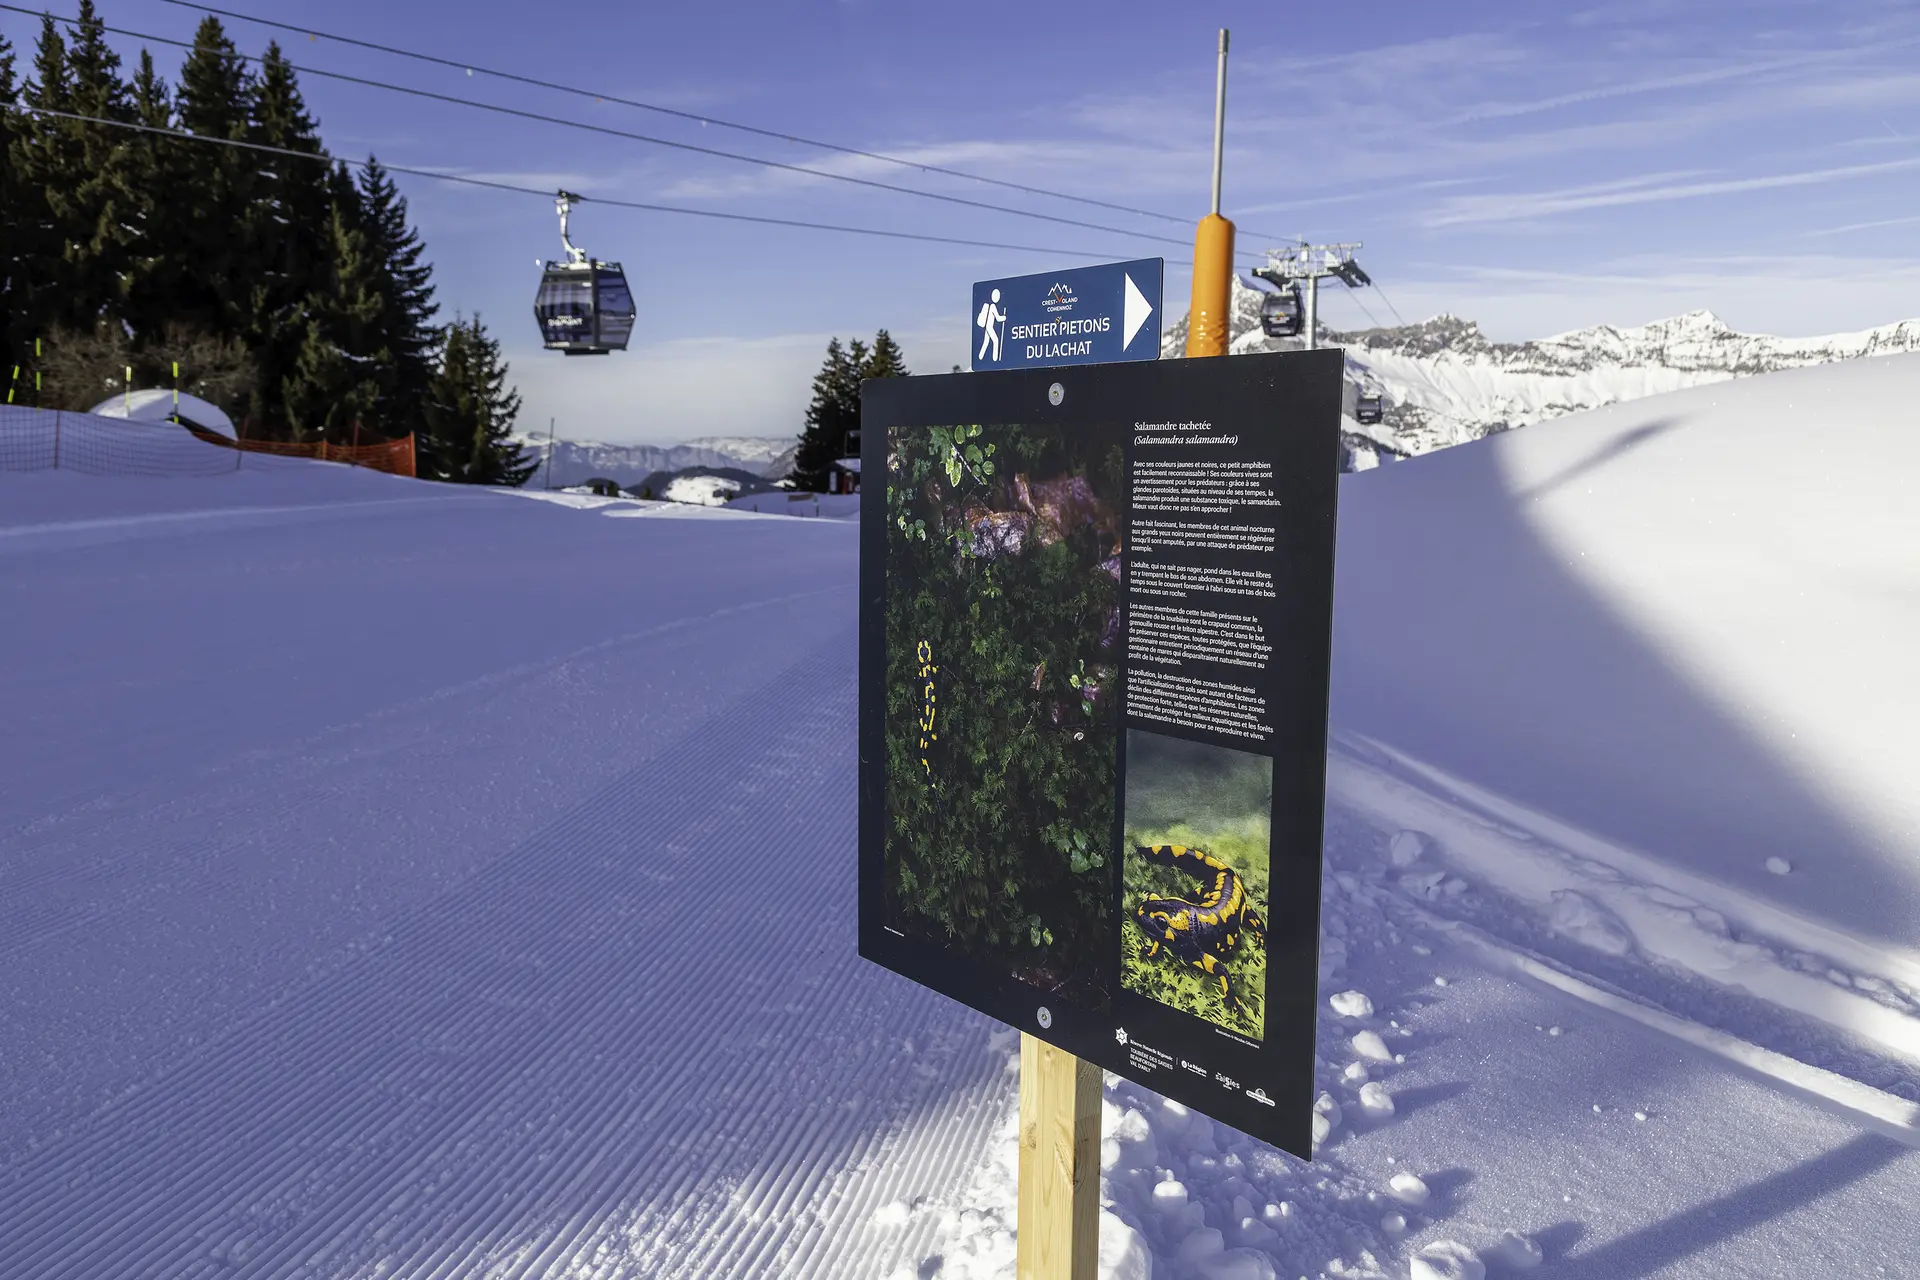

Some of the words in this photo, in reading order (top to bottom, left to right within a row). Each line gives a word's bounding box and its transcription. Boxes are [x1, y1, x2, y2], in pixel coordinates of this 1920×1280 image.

[1012, 322, 1057, 340] SENTIER
[1060, 317, 1110, 335] PIETONS
[1026, 344, 1042, 359] DU
[1046, 341, 1092, 357] LACHAT
[1135, 422, 1177, 431] Salamandre
[1179, 421, 1211, 430] tachetée
[1134, 435, 1184, 446] (Salamandra
[1185, 435, 1238, 446] salamandra)
[1177, 461, 1194, 469] jaunes
[1228, 461, 1240, 470] petit
[1241, 461, 1271, 470] amphibien
[1133, 486, 1152, 494] glandes
[1229, 479, 1244, 488] grâce
[1161, 495, 1179, 504] produit
[1201, 505, 1229, 515] approcher
[1250, 525, 1275, 533] nocturne
[1151, 562, 1159, 571] qui
[1204, 567, 1218, 576] pond
[1256, 570, 1271, 579] libres
[1130, 577, 1146, 587] temps
[1164, 580, 1183, 588] couvert
[1184, 582, 1205, 591] forestier
[1264, 589, 1276, 598] bois
[1139, 603, 1154, 611] autres
[1155, 605, 1178, 614] membres
[1186, 608, 1199, 616] cette
[1200, 610, 1218, 618] famille
[1219, 612, 1242, 623] présents
[1136, 627, 1159, 638] préserver
[1192, 635, 1209, 643] toutes
[1239, 643, 1249, 651] que
[1129, 651, 1141, 661] profit
[1192, 677, 1202, 686] des
[1219, 682, 1242, 692] humides
[1243, 685, 1255, 694] ainsi
[1174, 700, 1187, 709] telles
[1188, 705, 1198, 713] que
[1208, 706, 1230, 716] réserves
[1127, 708, 1138, 716] dont
[1177, 717, 1194, 727] besoin
[1194, 723, 1207, 731] pour
[1243, 730, 1249, 738] et
